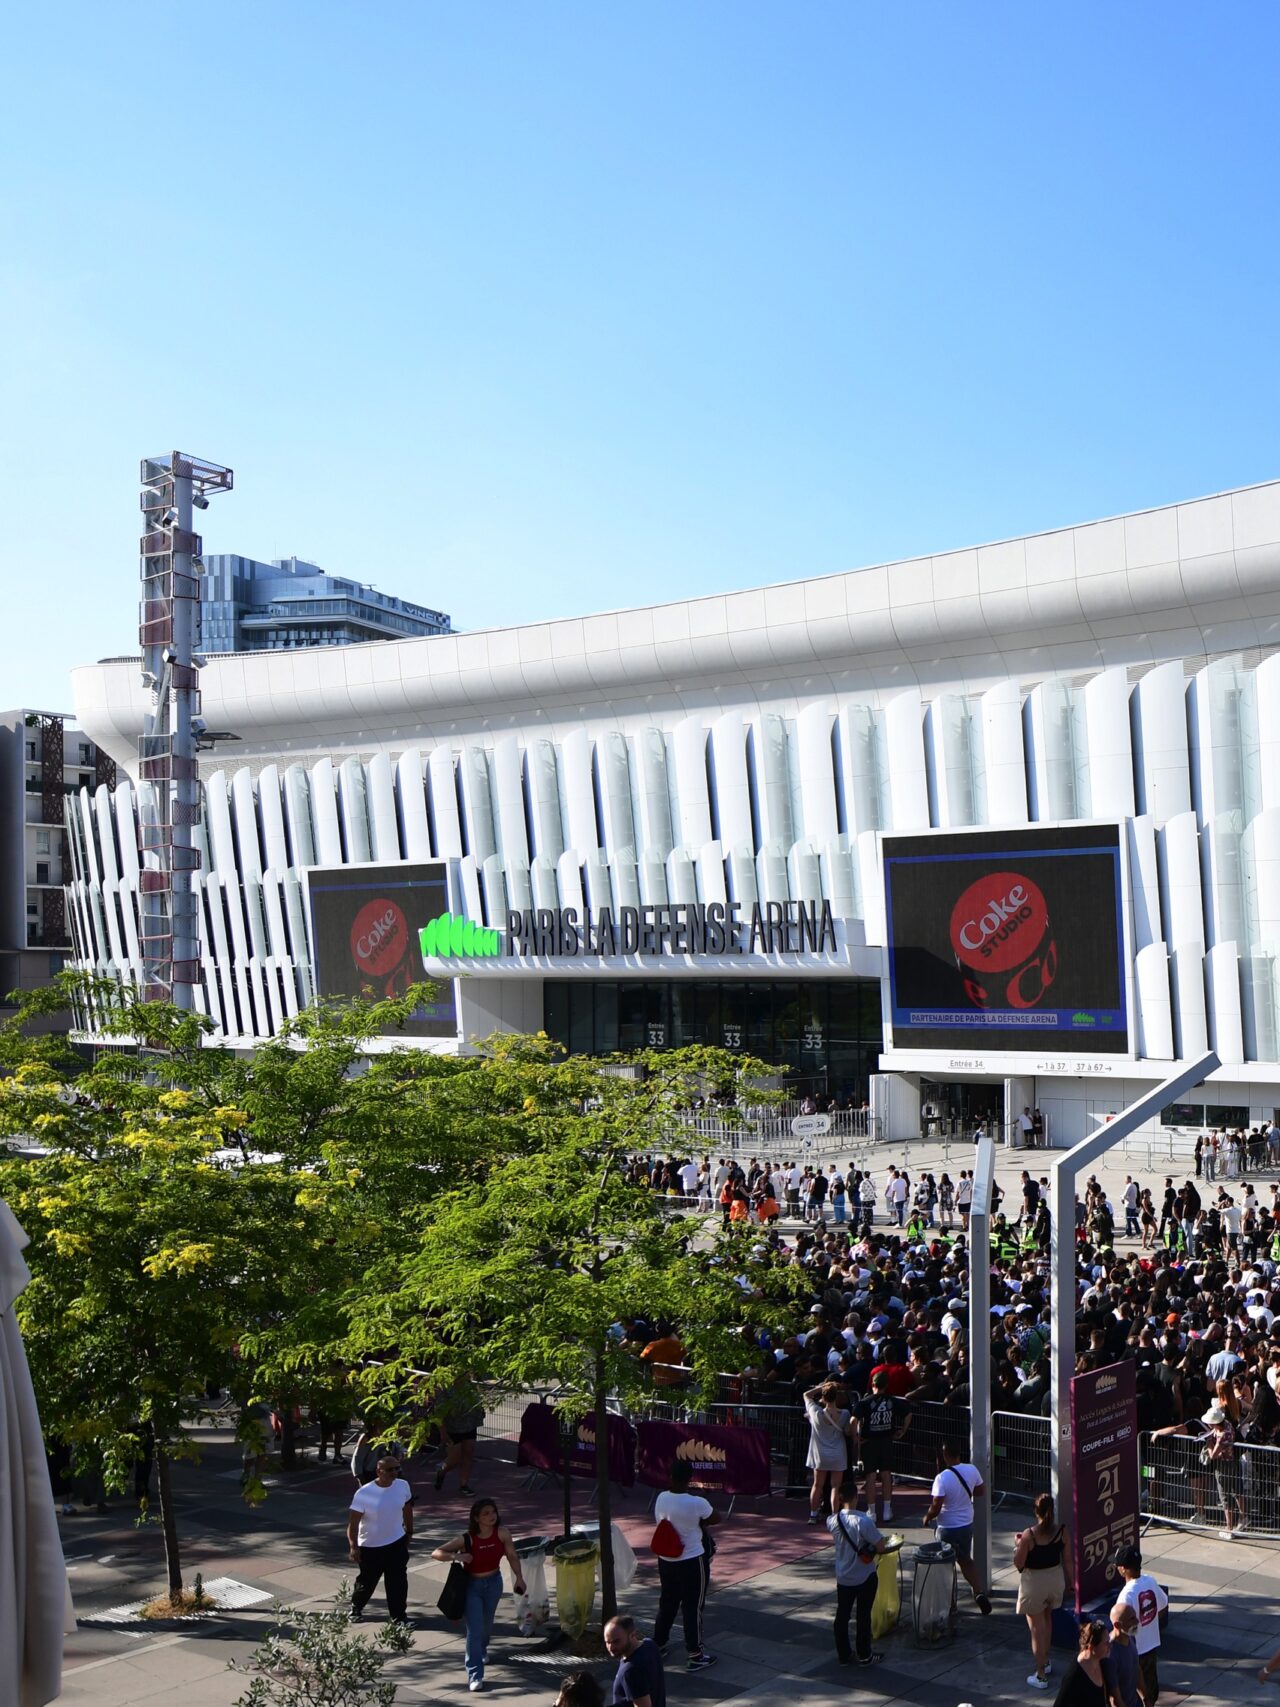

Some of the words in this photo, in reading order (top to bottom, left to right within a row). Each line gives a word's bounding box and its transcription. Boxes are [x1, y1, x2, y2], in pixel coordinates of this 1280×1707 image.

[406, 607, 438, 622] VINCI
[960, 885, 1028, 950] Coke
[356, 908, 397, 959] Coke
[505, 907, 579, 957] PARIS
[582, 906, 616, 957] LA
[620, 902, 743, 957] DEFENSE
[748, 899, 838, 954] ARENA
[981, 906, 1032, 957] STUDIO
[911, 1014, 956, 1023] PARTENAIRE
[956, 1014, 965, 1023] DE
[966, 1014, 986, 1023] PARIS
[987, 1015, 996, 1023] LA
[1031, 1015, 1057, 1024] ARENA
[649, 1031, 664, 1045] 33
[724, 1032, 741, 1047] 33
[805, 1034, 822, 1049] 33
[950, 1060, 972, 1068] Entrée
[1082, 1434, 1115, 1453] COUPE-FILE
[1097, 1465, 1120, 1502] 21
[1083, 1538, 1108, 1573] 39
